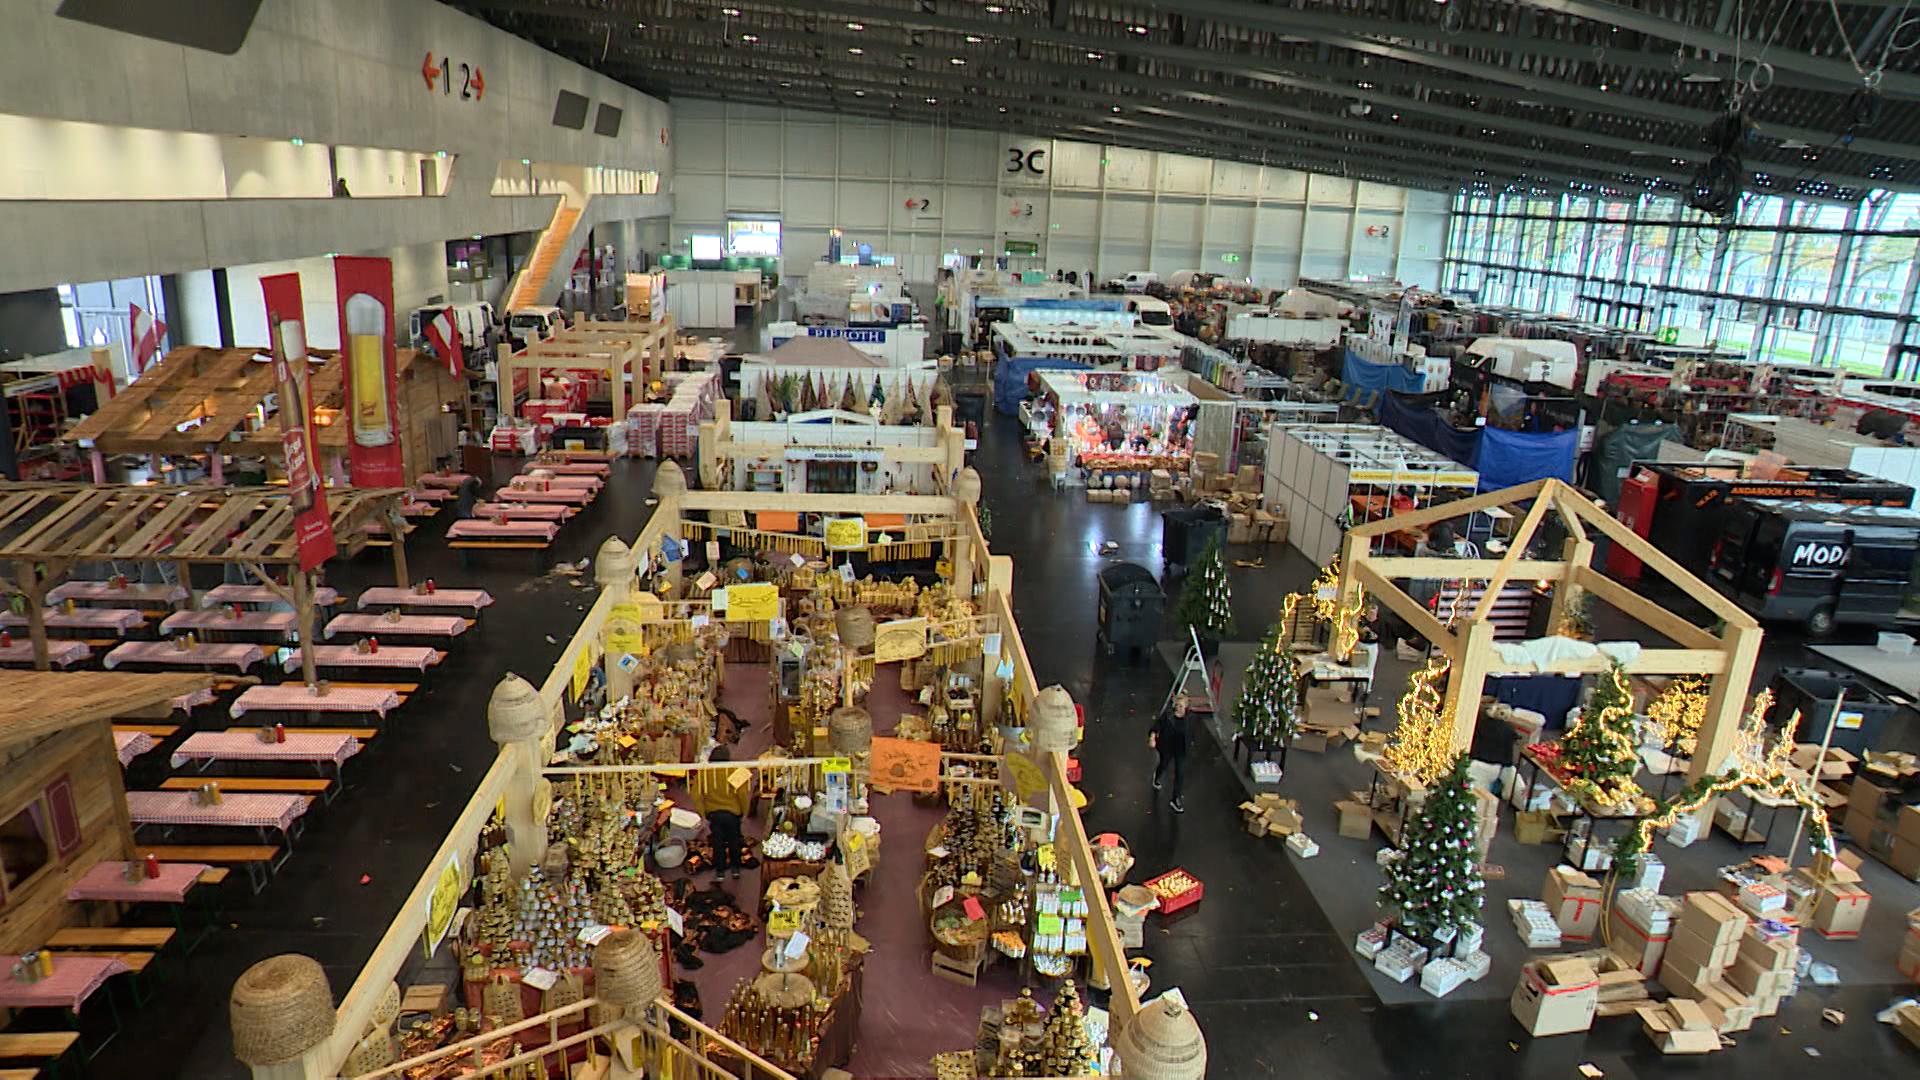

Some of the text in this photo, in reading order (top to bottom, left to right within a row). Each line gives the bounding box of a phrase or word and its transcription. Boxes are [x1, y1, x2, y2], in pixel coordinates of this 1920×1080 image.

[441, 57, 471, 98] 1 2
[1007, 148, 1046, 174] 3C
[920, 199, 930, 211] 2
[1025, 204, 1033, 217] 3
[1381, 225, 1389, 238] 2
